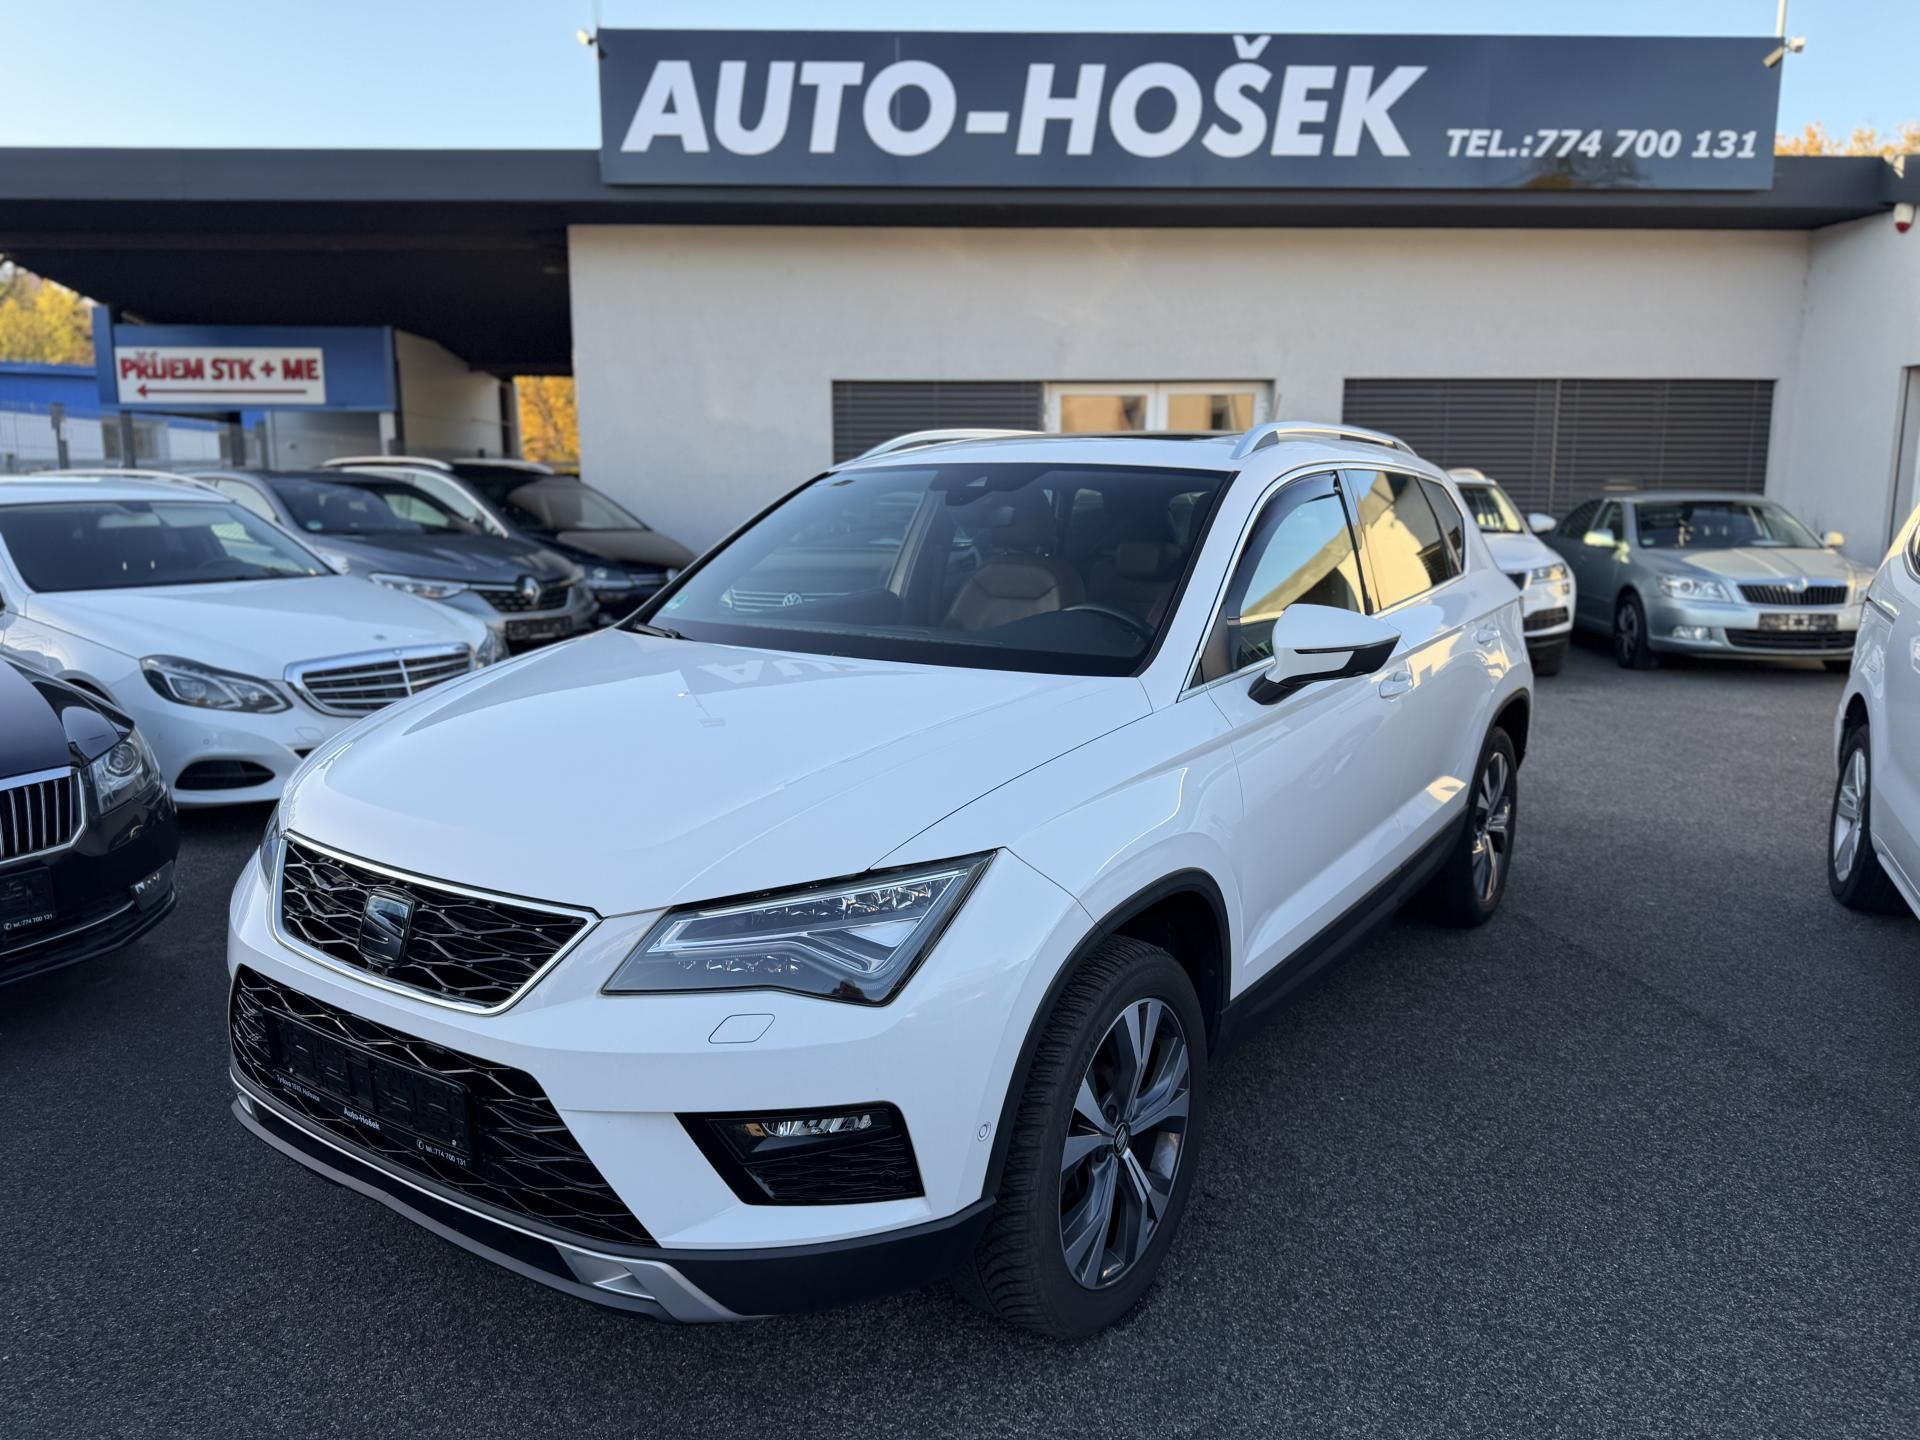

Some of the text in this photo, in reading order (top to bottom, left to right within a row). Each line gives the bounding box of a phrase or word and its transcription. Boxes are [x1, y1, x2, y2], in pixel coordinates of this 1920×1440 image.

[619, 34, 1430, 159] AUTO-HOŠEK
[1446, 128, 1758, 159] TEL.:774 700 131
[119, 350, 320, 381] PŘÍJEM STK + ME
[446, 1152, 456, 1163] 700
[456, 1154, 467, 1167] 131
